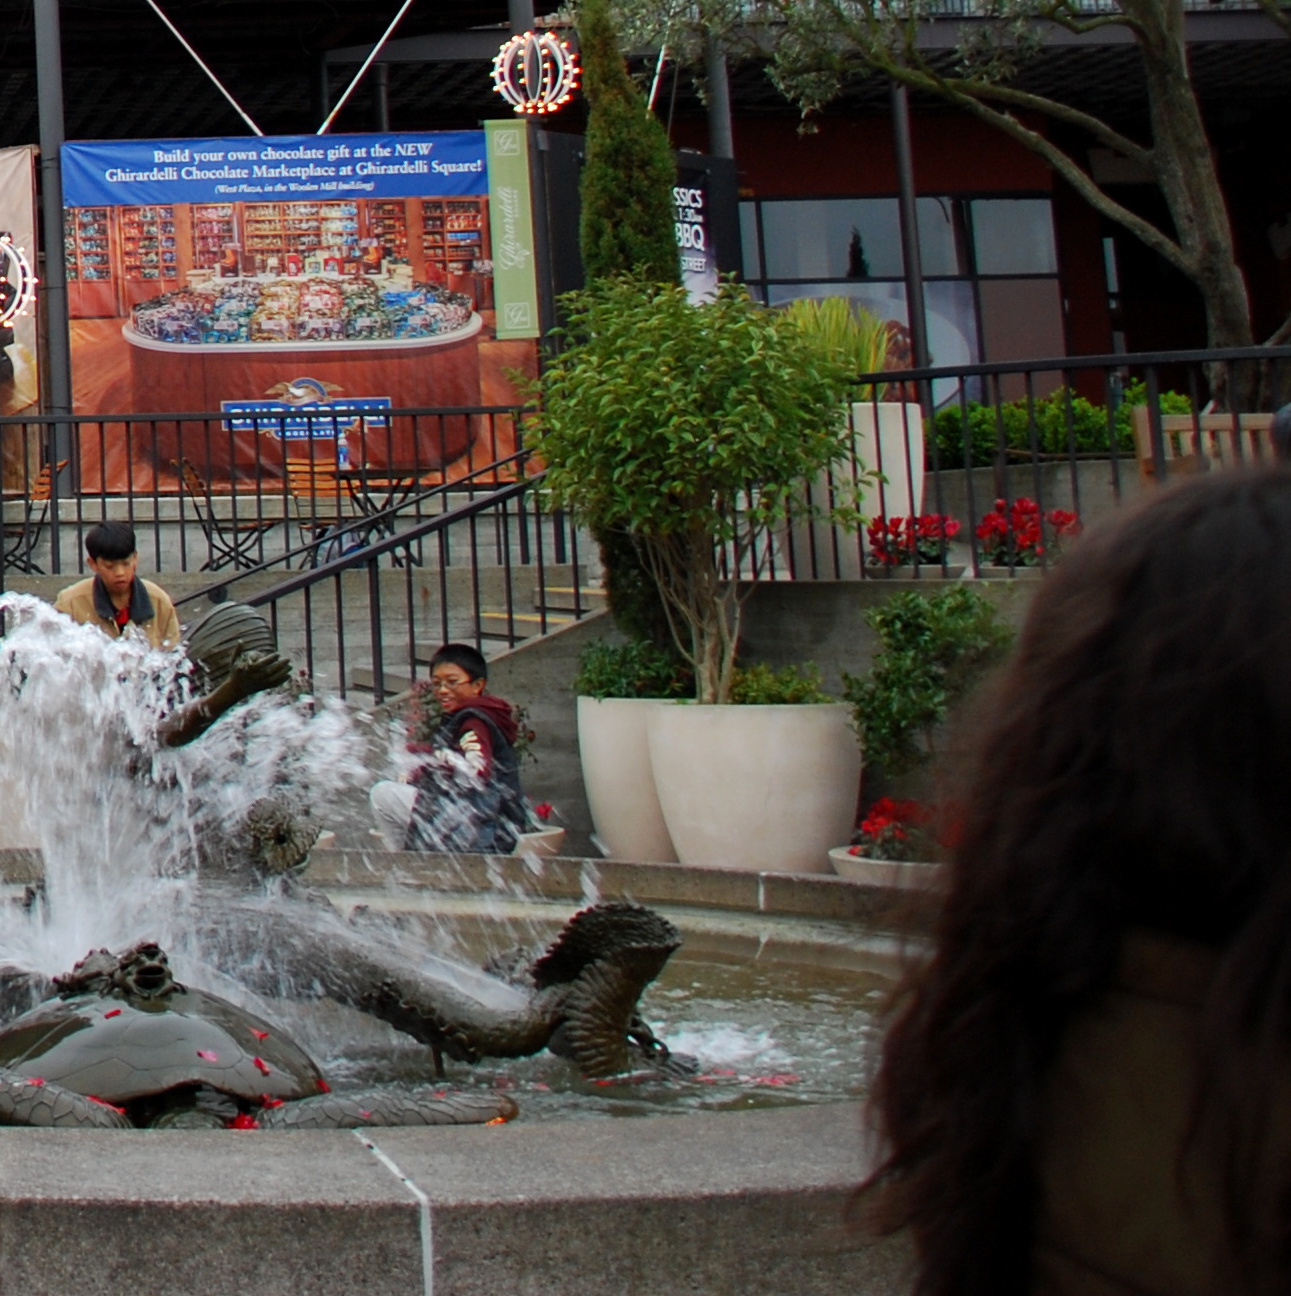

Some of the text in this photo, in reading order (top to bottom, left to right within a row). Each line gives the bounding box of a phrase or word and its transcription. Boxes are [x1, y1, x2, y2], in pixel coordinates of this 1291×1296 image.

[153, 143, 433, 165] Build your own chocolate gift at the NEW
[105, 159, 482, 182] Ghirardelli Chocolate Marketplace at Ghirardelli Square!
[672, 186, 702, 208] SSICS
[675, 222, 705, 252] BBQ
